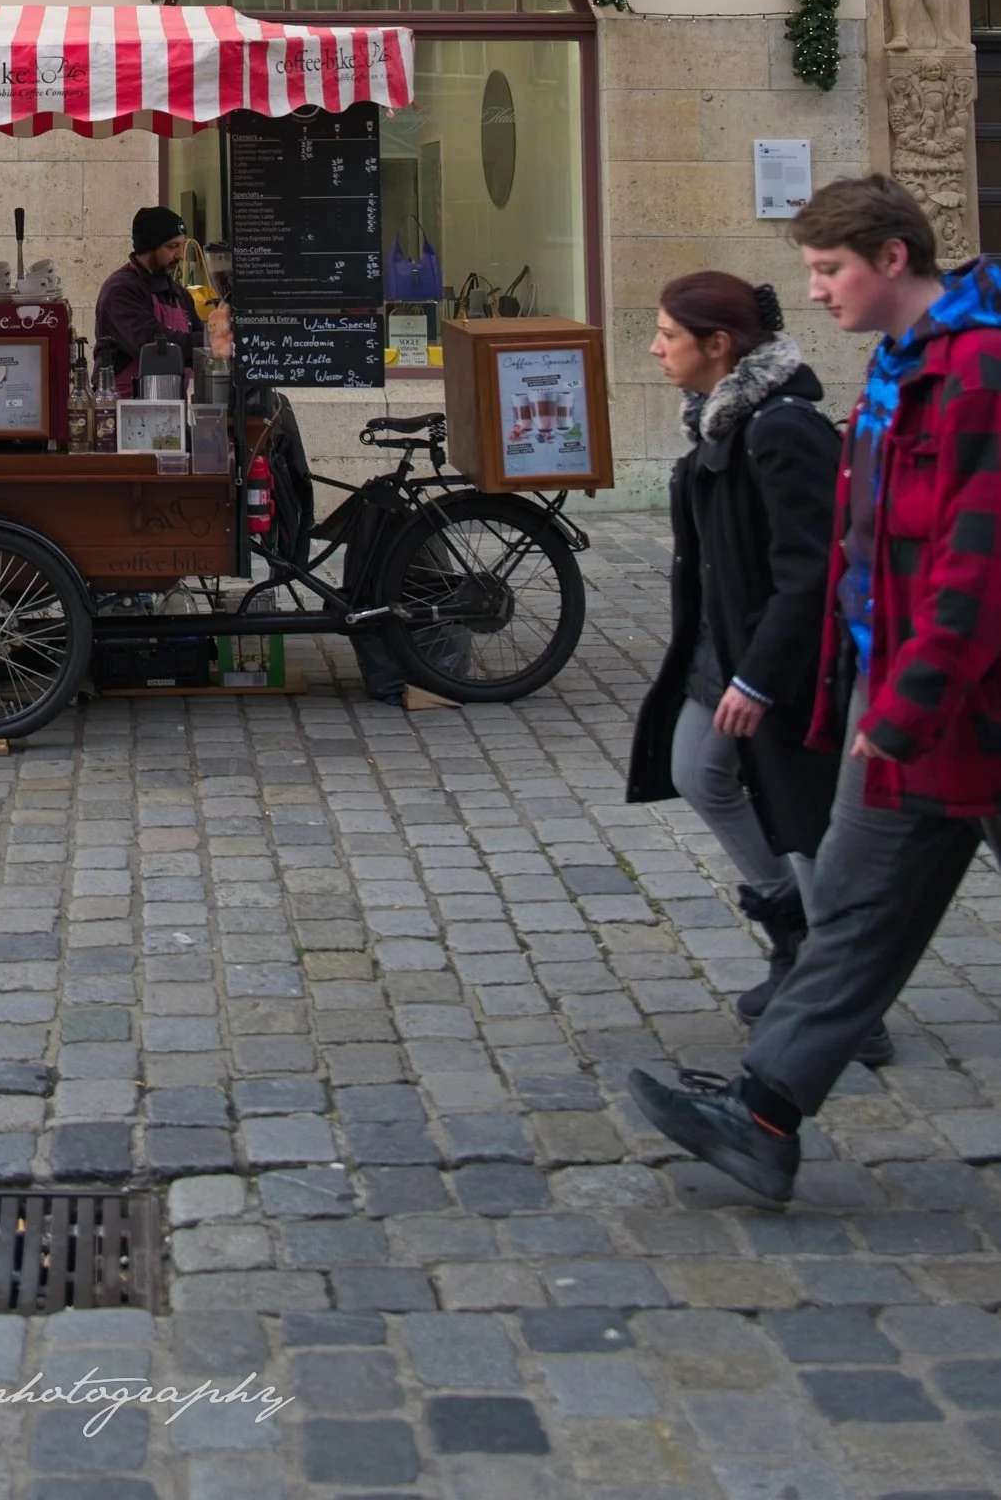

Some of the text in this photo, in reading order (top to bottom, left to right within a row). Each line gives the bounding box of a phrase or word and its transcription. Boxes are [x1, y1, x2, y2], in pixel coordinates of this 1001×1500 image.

[276, 47, 355, 74] coffee-bike
[18, 88, 43, 99] Coffee
[45, 88, 84, 99] Company
[235, 315, 268, 323] Seasonals
[276, 315, 297, 323] Extras
[303, 317, 378, 330] Winter Specials
[250, 334, 277, 350] Magic
[249, 352, 280, 366] Vanille
[305, 354, 332, 365] Latte
